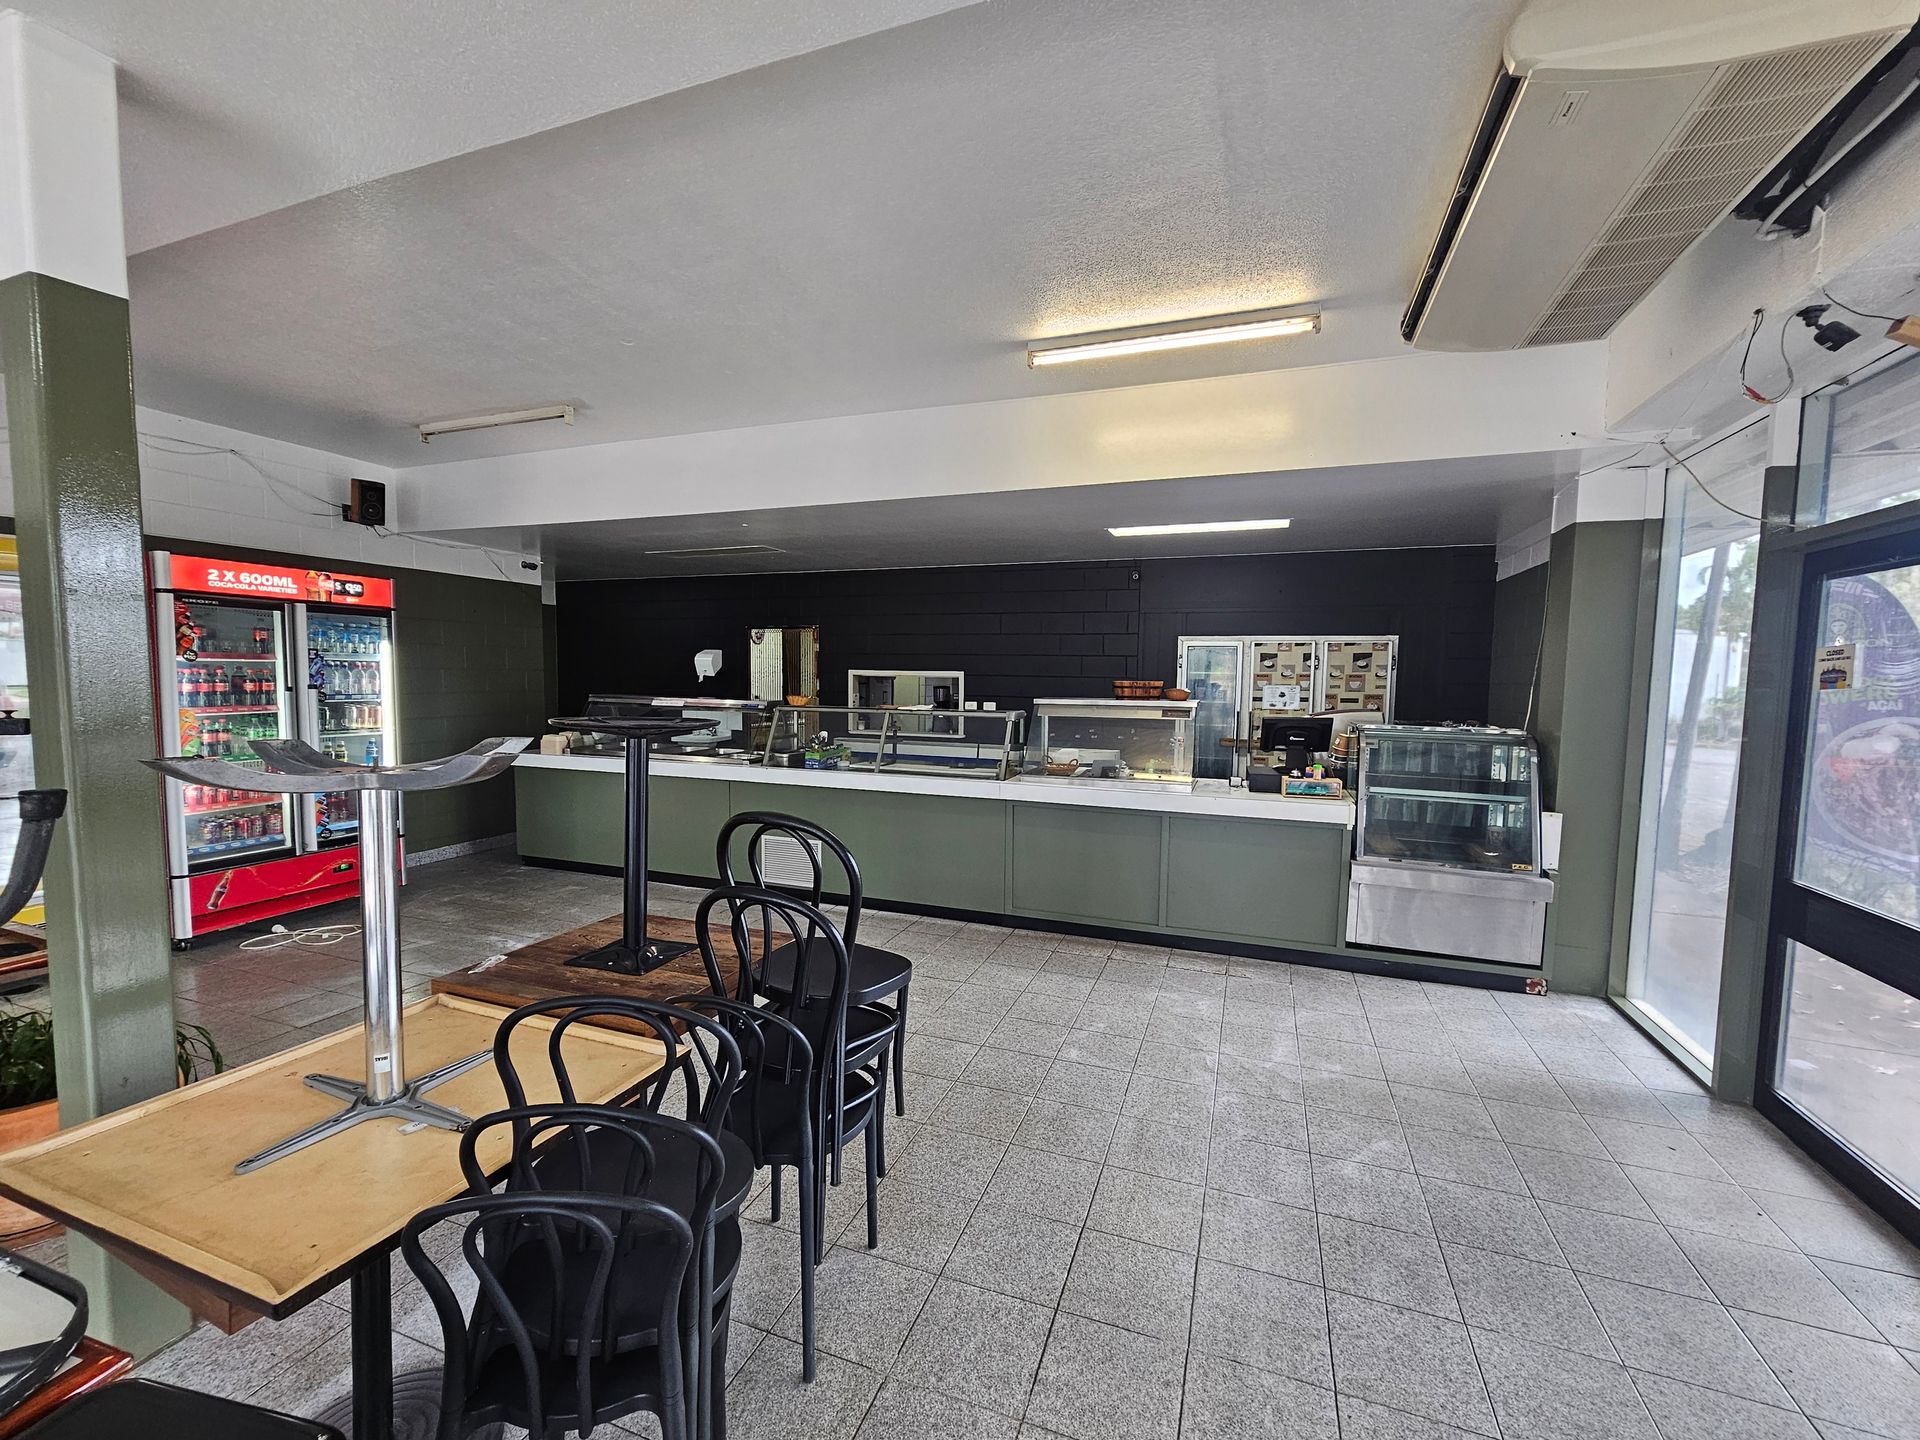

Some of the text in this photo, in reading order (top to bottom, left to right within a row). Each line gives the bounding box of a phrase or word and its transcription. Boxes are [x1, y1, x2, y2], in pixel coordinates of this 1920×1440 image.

[207, 568, 298, 588] 2 X 600ML
[208, 580, 298, 594] COCA-COLA VARIETIES
